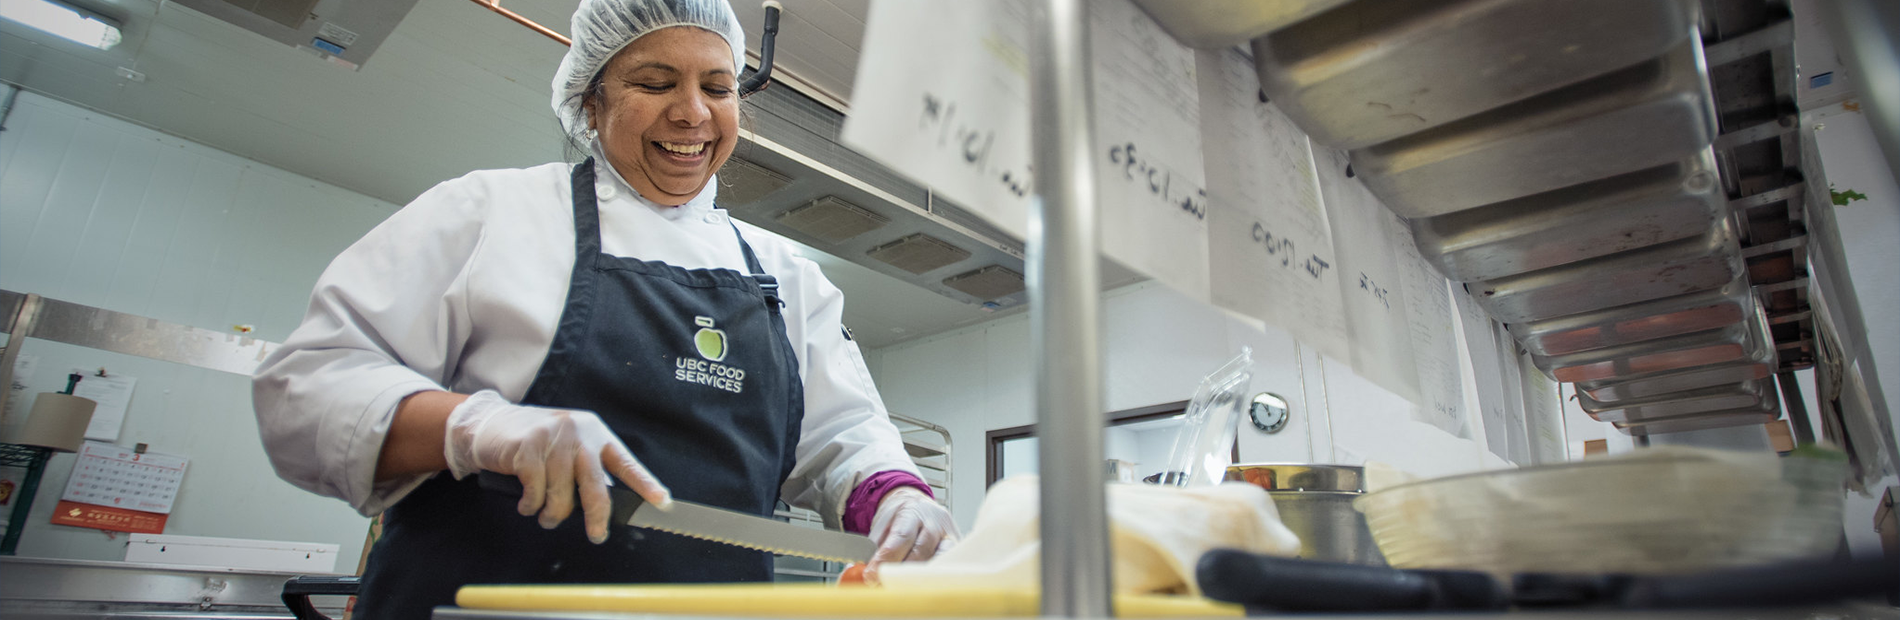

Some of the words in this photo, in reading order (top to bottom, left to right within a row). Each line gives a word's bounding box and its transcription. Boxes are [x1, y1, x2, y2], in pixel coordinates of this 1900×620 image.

[675, 369, 743, 393] SERVICES
[676, 357, 707, 372] UBC
[709, 363, 746, 382] FOOD
